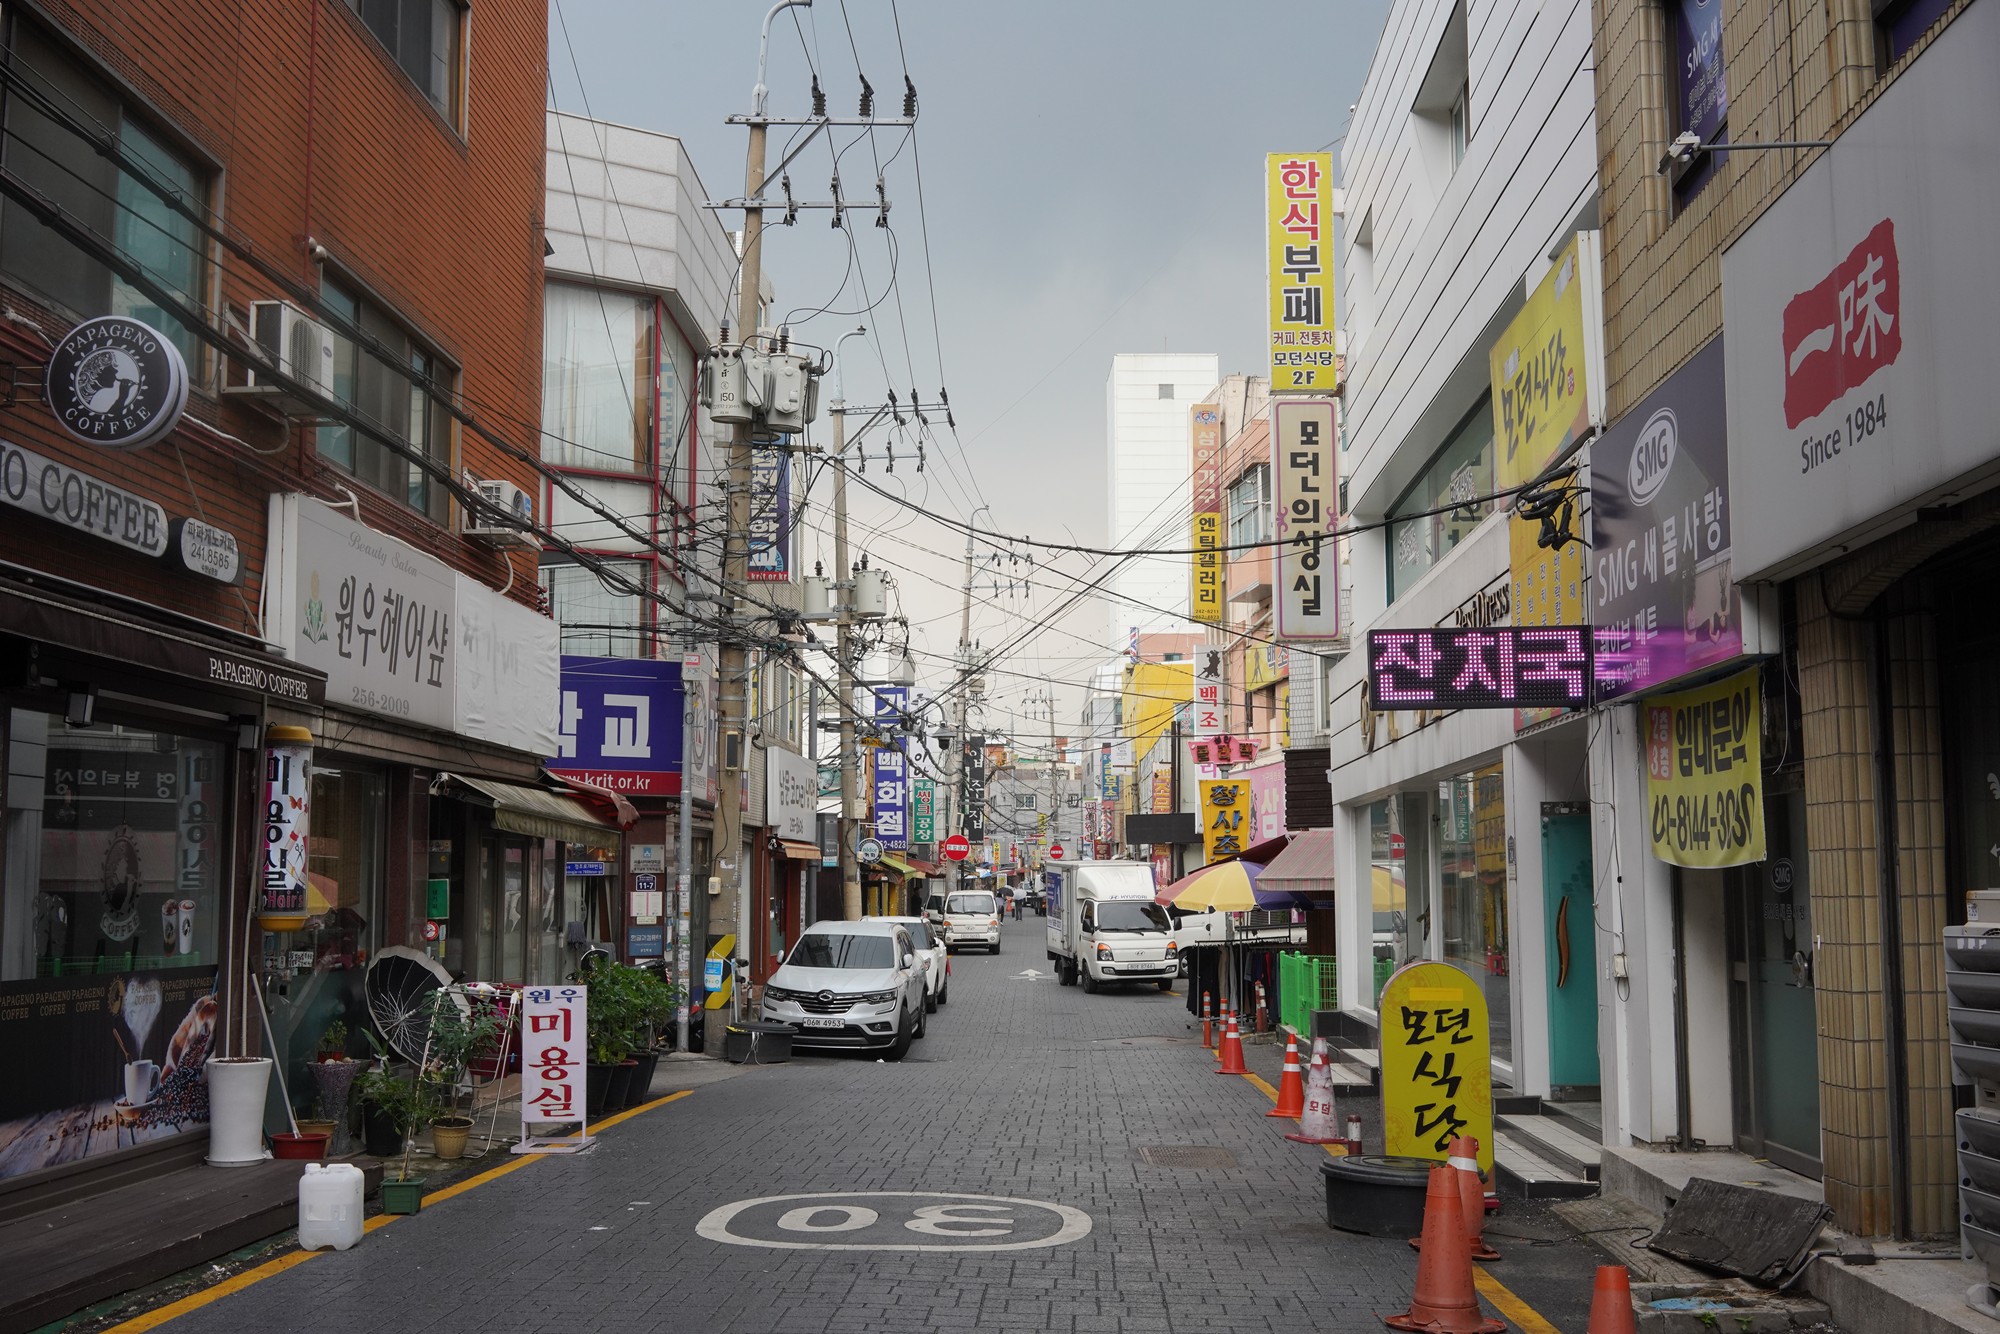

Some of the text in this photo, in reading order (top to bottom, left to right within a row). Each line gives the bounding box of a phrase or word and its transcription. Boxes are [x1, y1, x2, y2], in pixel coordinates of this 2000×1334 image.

[1687, 31, 1709, 79] SMG
[1789, 252, 1895, 377] 一味
[66, 324, 157, 356] PAPAGENO
[1274, 351, 1333, 366] 모던식당
[1292, 370, 1315, 385] 2F
[65, 406, 151, 435] COFFEE
[1801, 393, 1887, 474] Since 1984
[1636, 428, 1668, 487] SMG
[0, 445, 160, 551] O COFFEE
[1290, 420, 1324, 617] 모던의상실
[187, 521, 236, 554] 파파게노커피
[191, 542, 230, 570] 241.8585
[349, 531, 418, 577] Beauty Salon
[1599, 539, 1638, 607] SMG
[335, 575, 449, 689] 원우헤어샵
[209, 658, 309, 701] PAPAGENO COFFEE
[1374, 631, 1585, 701] 잔치국
[352, 685, 410, 717] 256-2009
[1199, 685, 1219, 728] 백조
[1652, 710, 1668, 742] 2층
[1675, 687, 1750, 778] 임대문의
[1650, 746, 1669, 778] 3층
[263, 755, 292, 890] 미용실
[915, 790, 934, 841] 씽크공장
[638, 882, 654, 890] 11-7
[1775, 866, 1791, 884] SMG
[1, 1007, 29, 1021] COFFEE
[39, 1003, 66, 1017] COFFEE
[75, 1000, 100, 1013] COFFEE
[72, 987, 105, 1000] PAPAGENO
[526, 988, 583, 1004] 원우
[823, 1019, 841, 1027] 4953
[527, 1007, 581, 1118] 미용실
